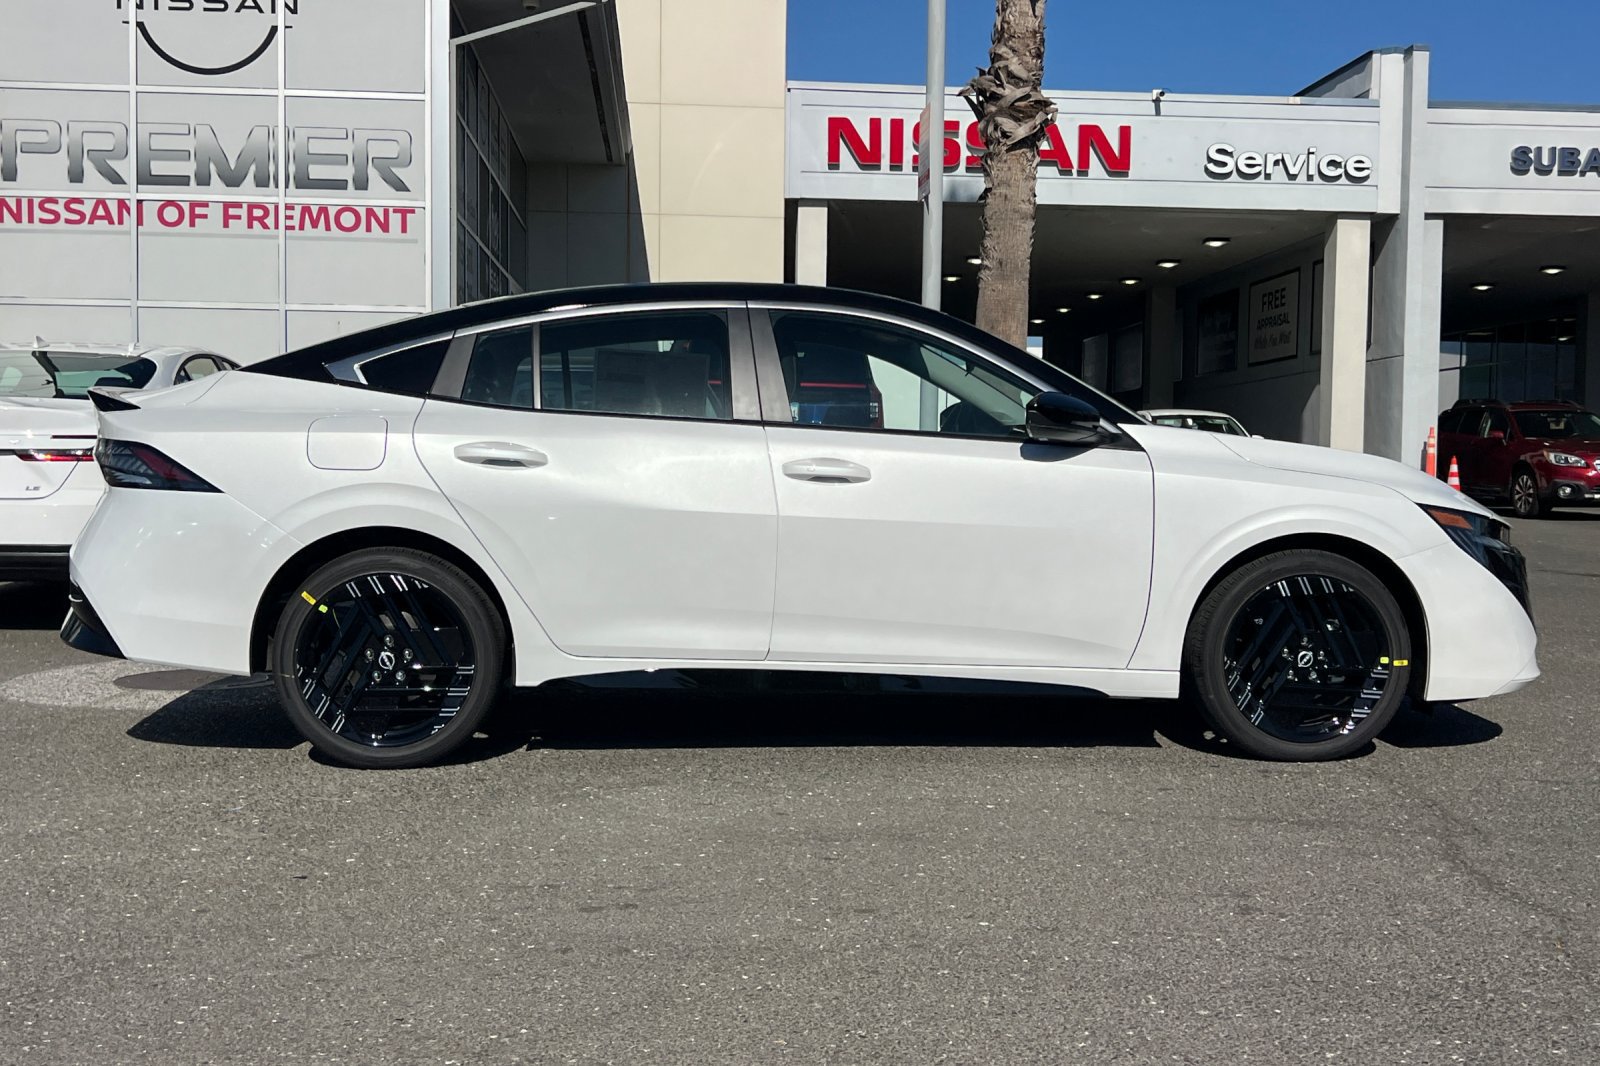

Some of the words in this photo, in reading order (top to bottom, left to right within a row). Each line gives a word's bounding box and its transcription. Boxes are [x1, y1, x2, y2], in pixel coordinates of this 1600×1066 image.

[0, 118, 411, 192] PREMIER
[1204, 142, 1373, 181] Service
[1510, 145, 1600, 176] SUBA
[0, 196, 144, 227] NISSAN
[156, 200, 210, 228] OF
[222, 202, 416, 234] FREMONT
[1262, 288, 1286, 312] FREE
[1257, 313, 1290, 330] APPRAISAL
